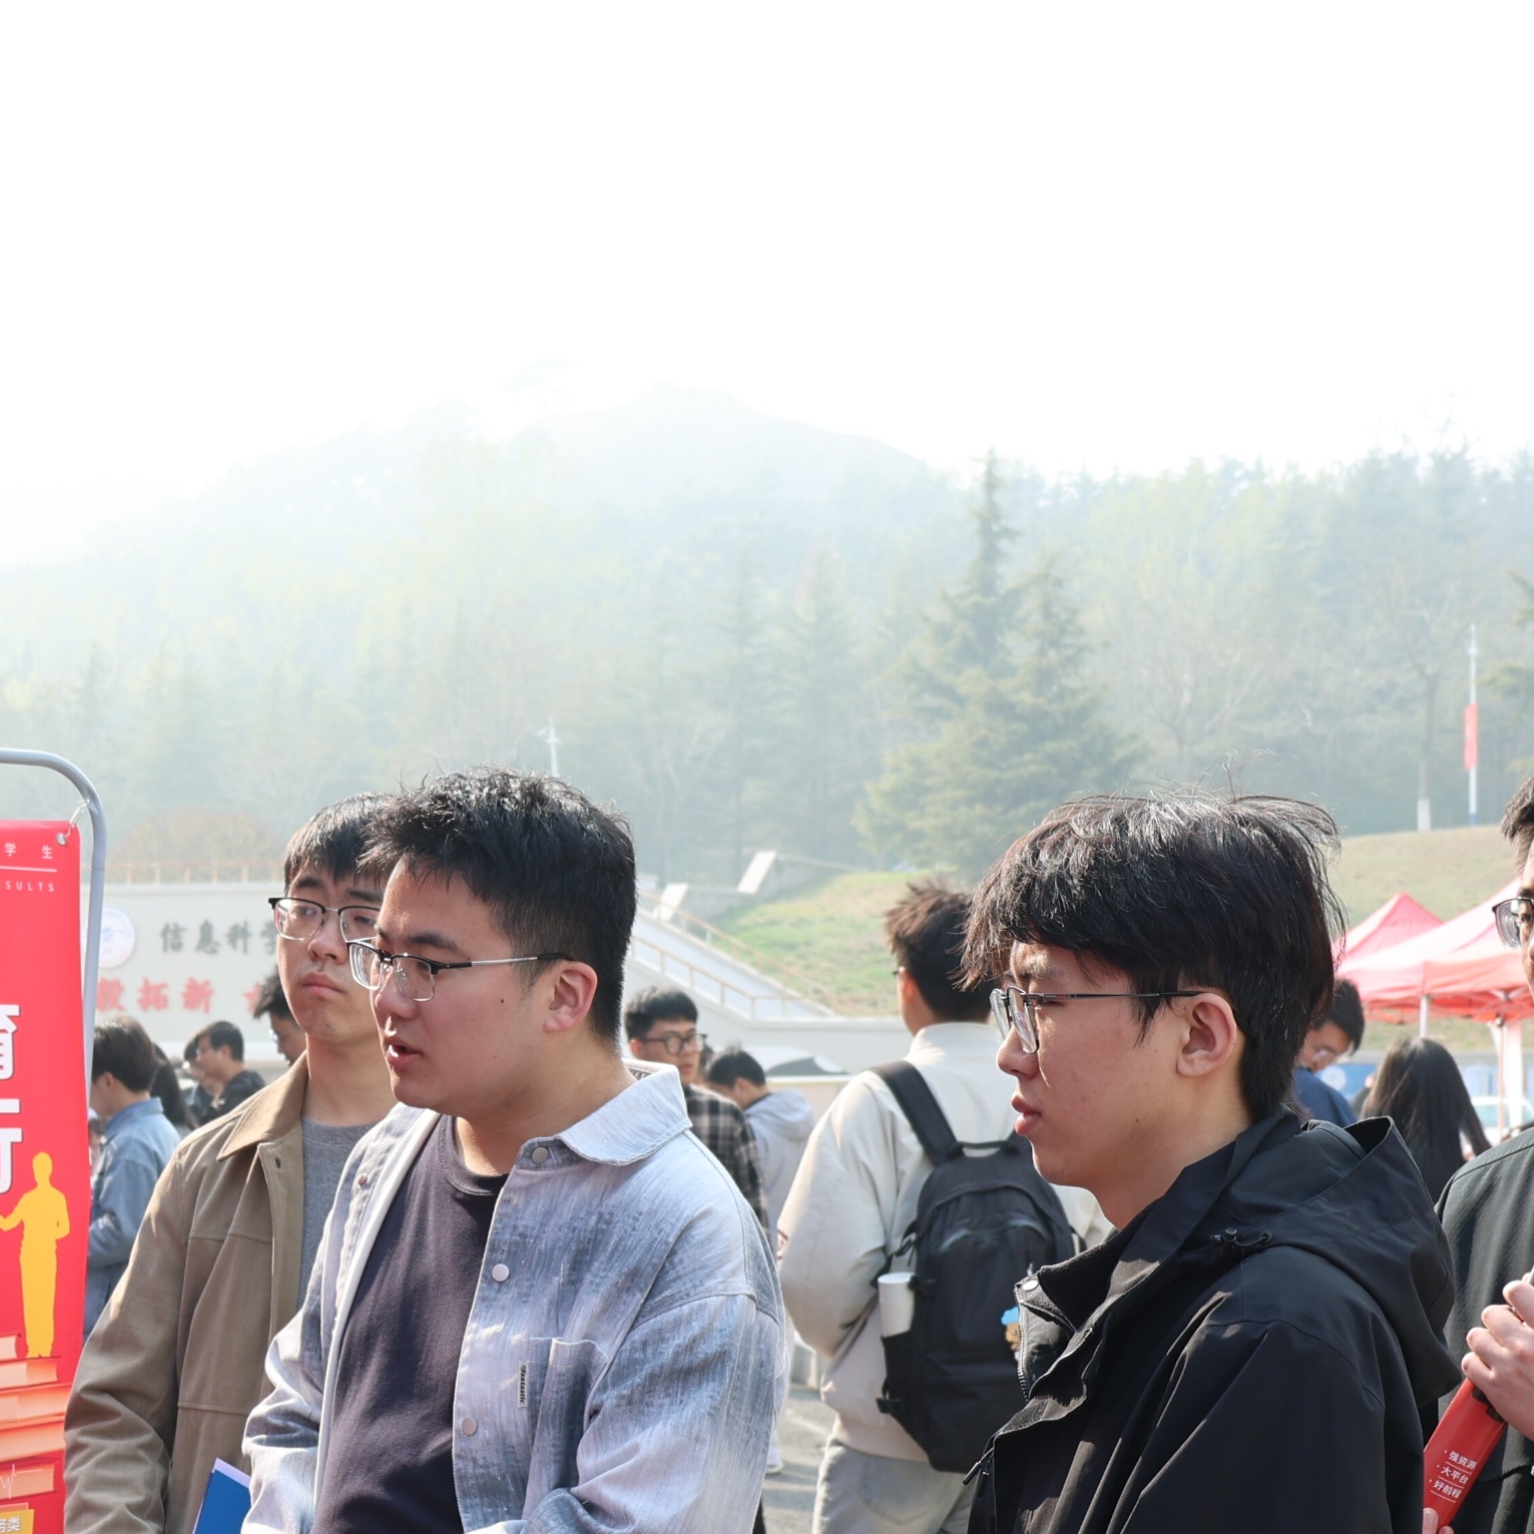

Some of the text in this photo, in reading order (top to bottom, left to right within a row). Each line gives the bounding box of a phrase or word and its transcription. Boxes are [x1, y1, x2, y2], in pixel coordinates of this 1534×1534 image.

[1448, 1450, 1478, 1470] 强资源
[1440, 1465, 1469, 1485] 大平台
[1432, 1479, 1463, 1499] 好前程
